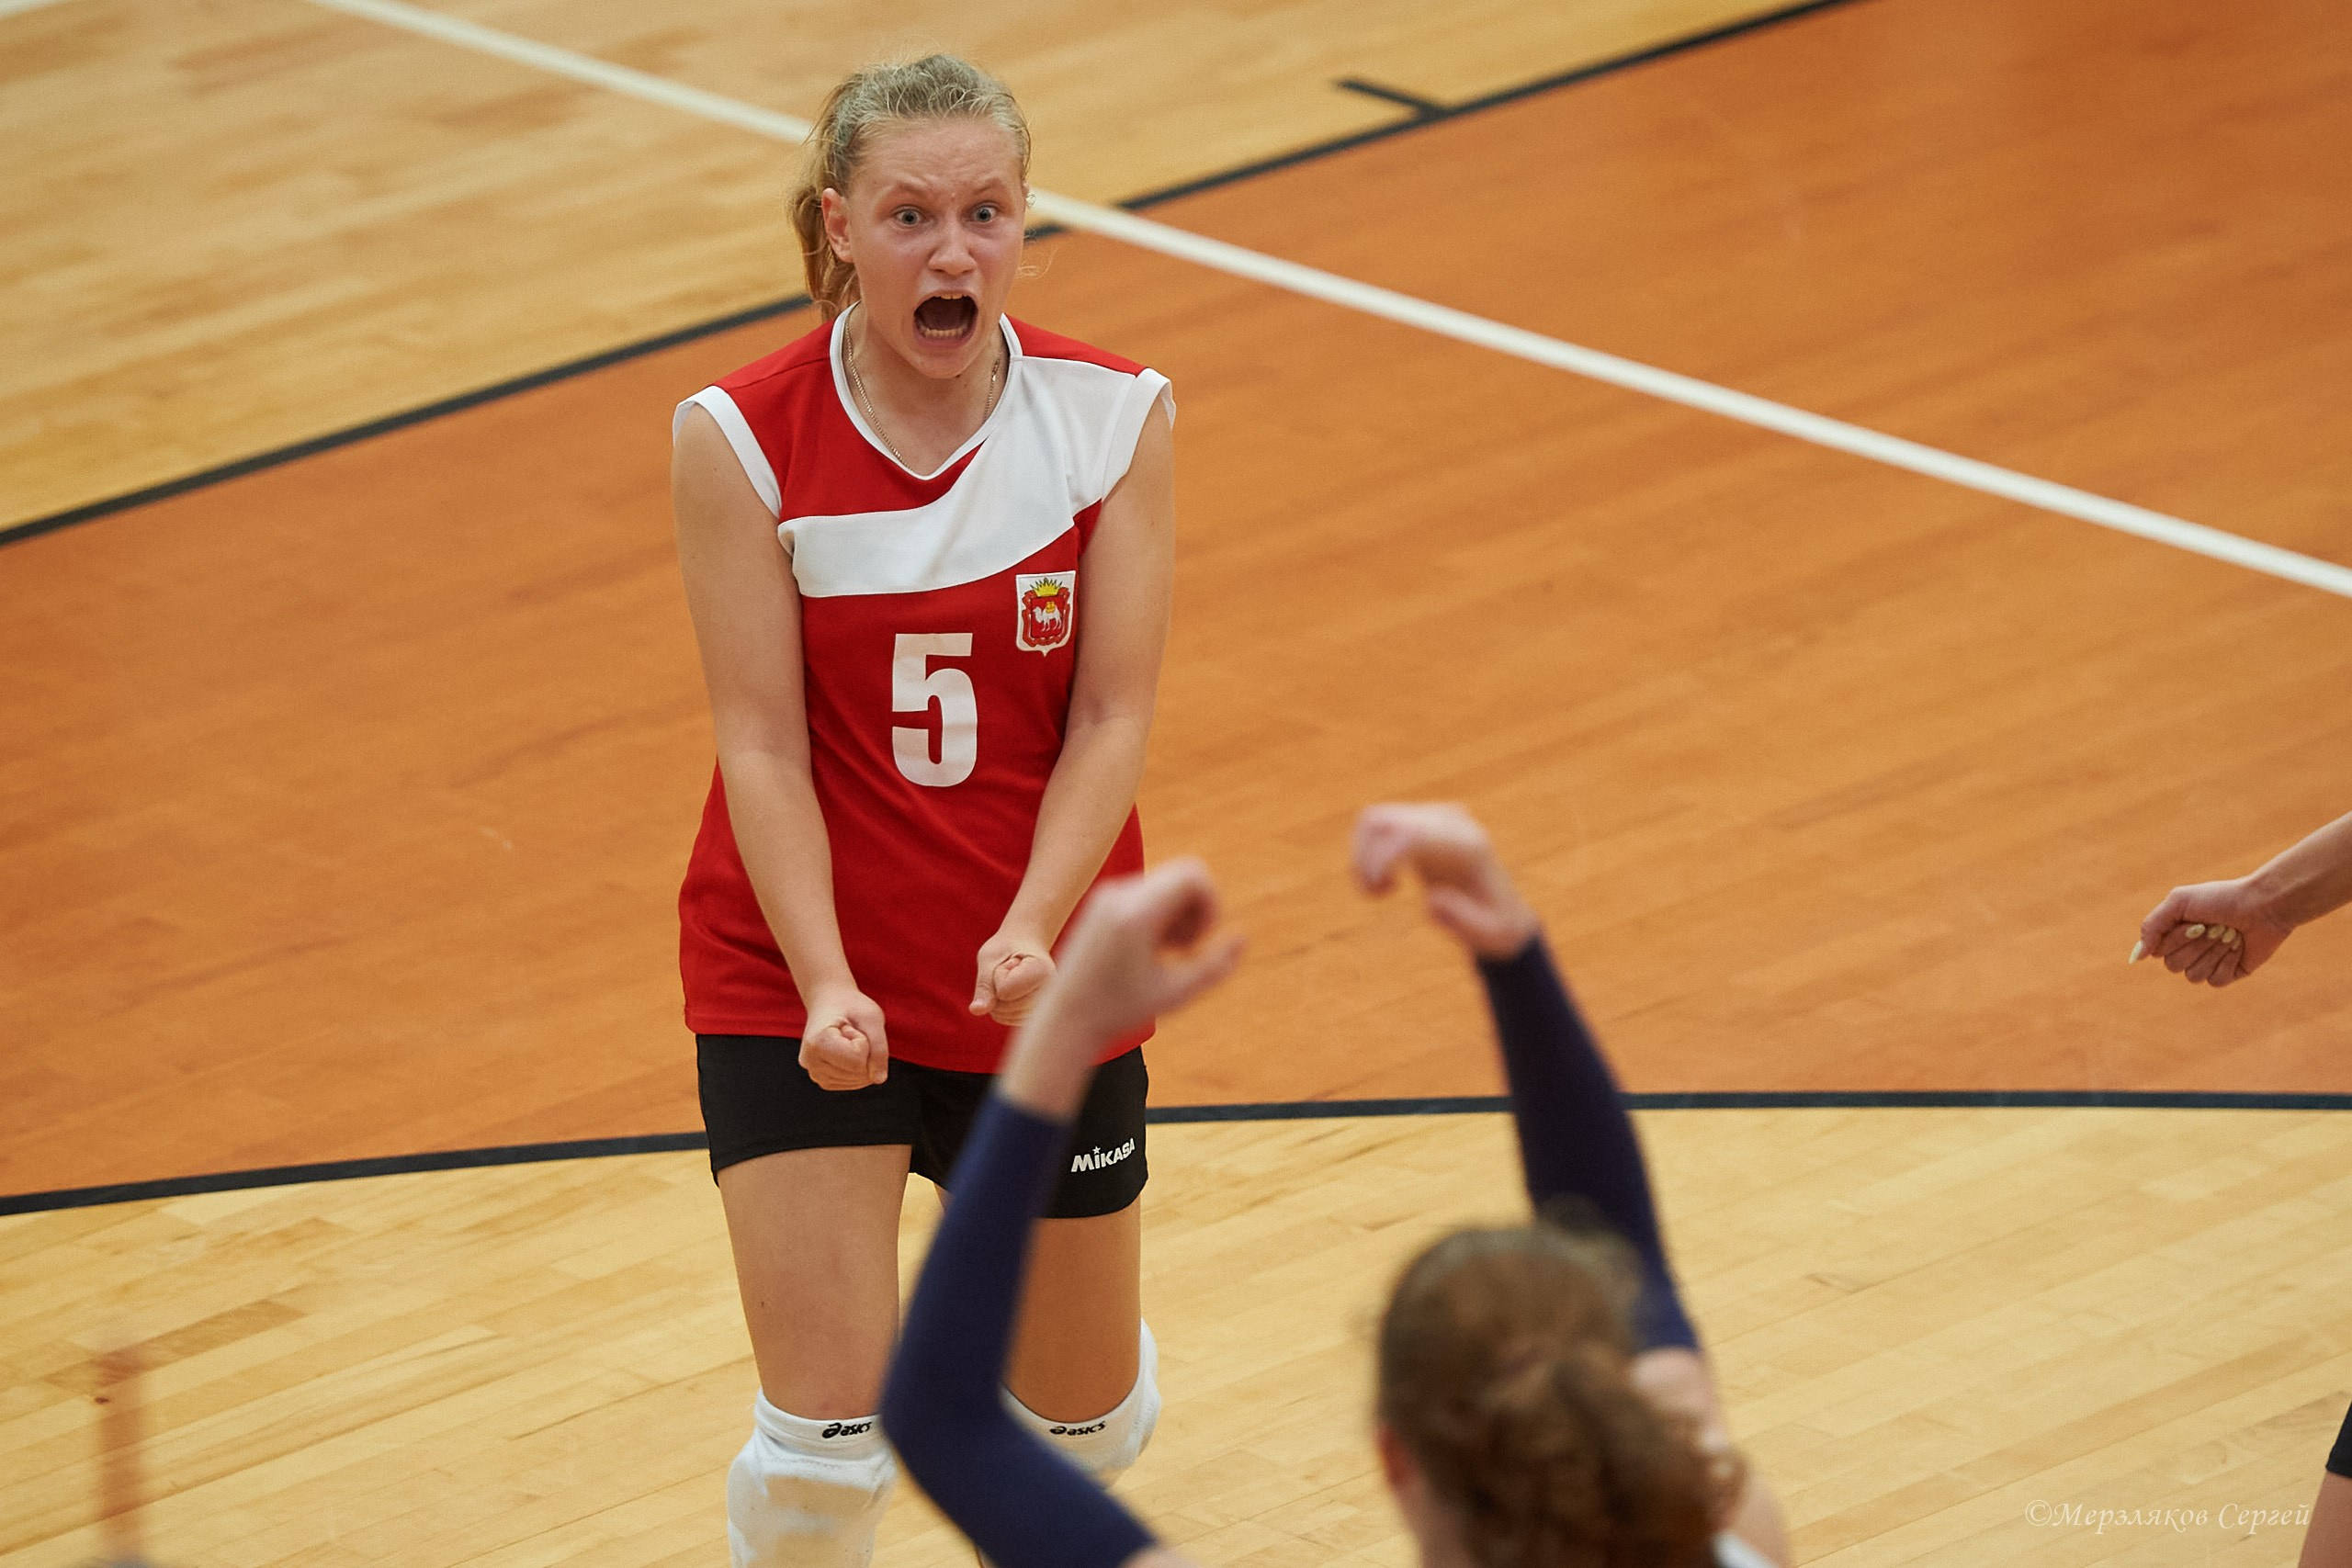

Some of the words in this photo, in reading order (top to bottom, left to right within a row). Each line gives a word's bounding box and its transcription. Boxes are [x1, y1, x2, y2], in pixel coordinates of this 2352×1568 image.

[892, 633, 978, 787] 5
[840, 1421, 873, 1437] asics
[1067, 1420, 1106, 1436] asics
